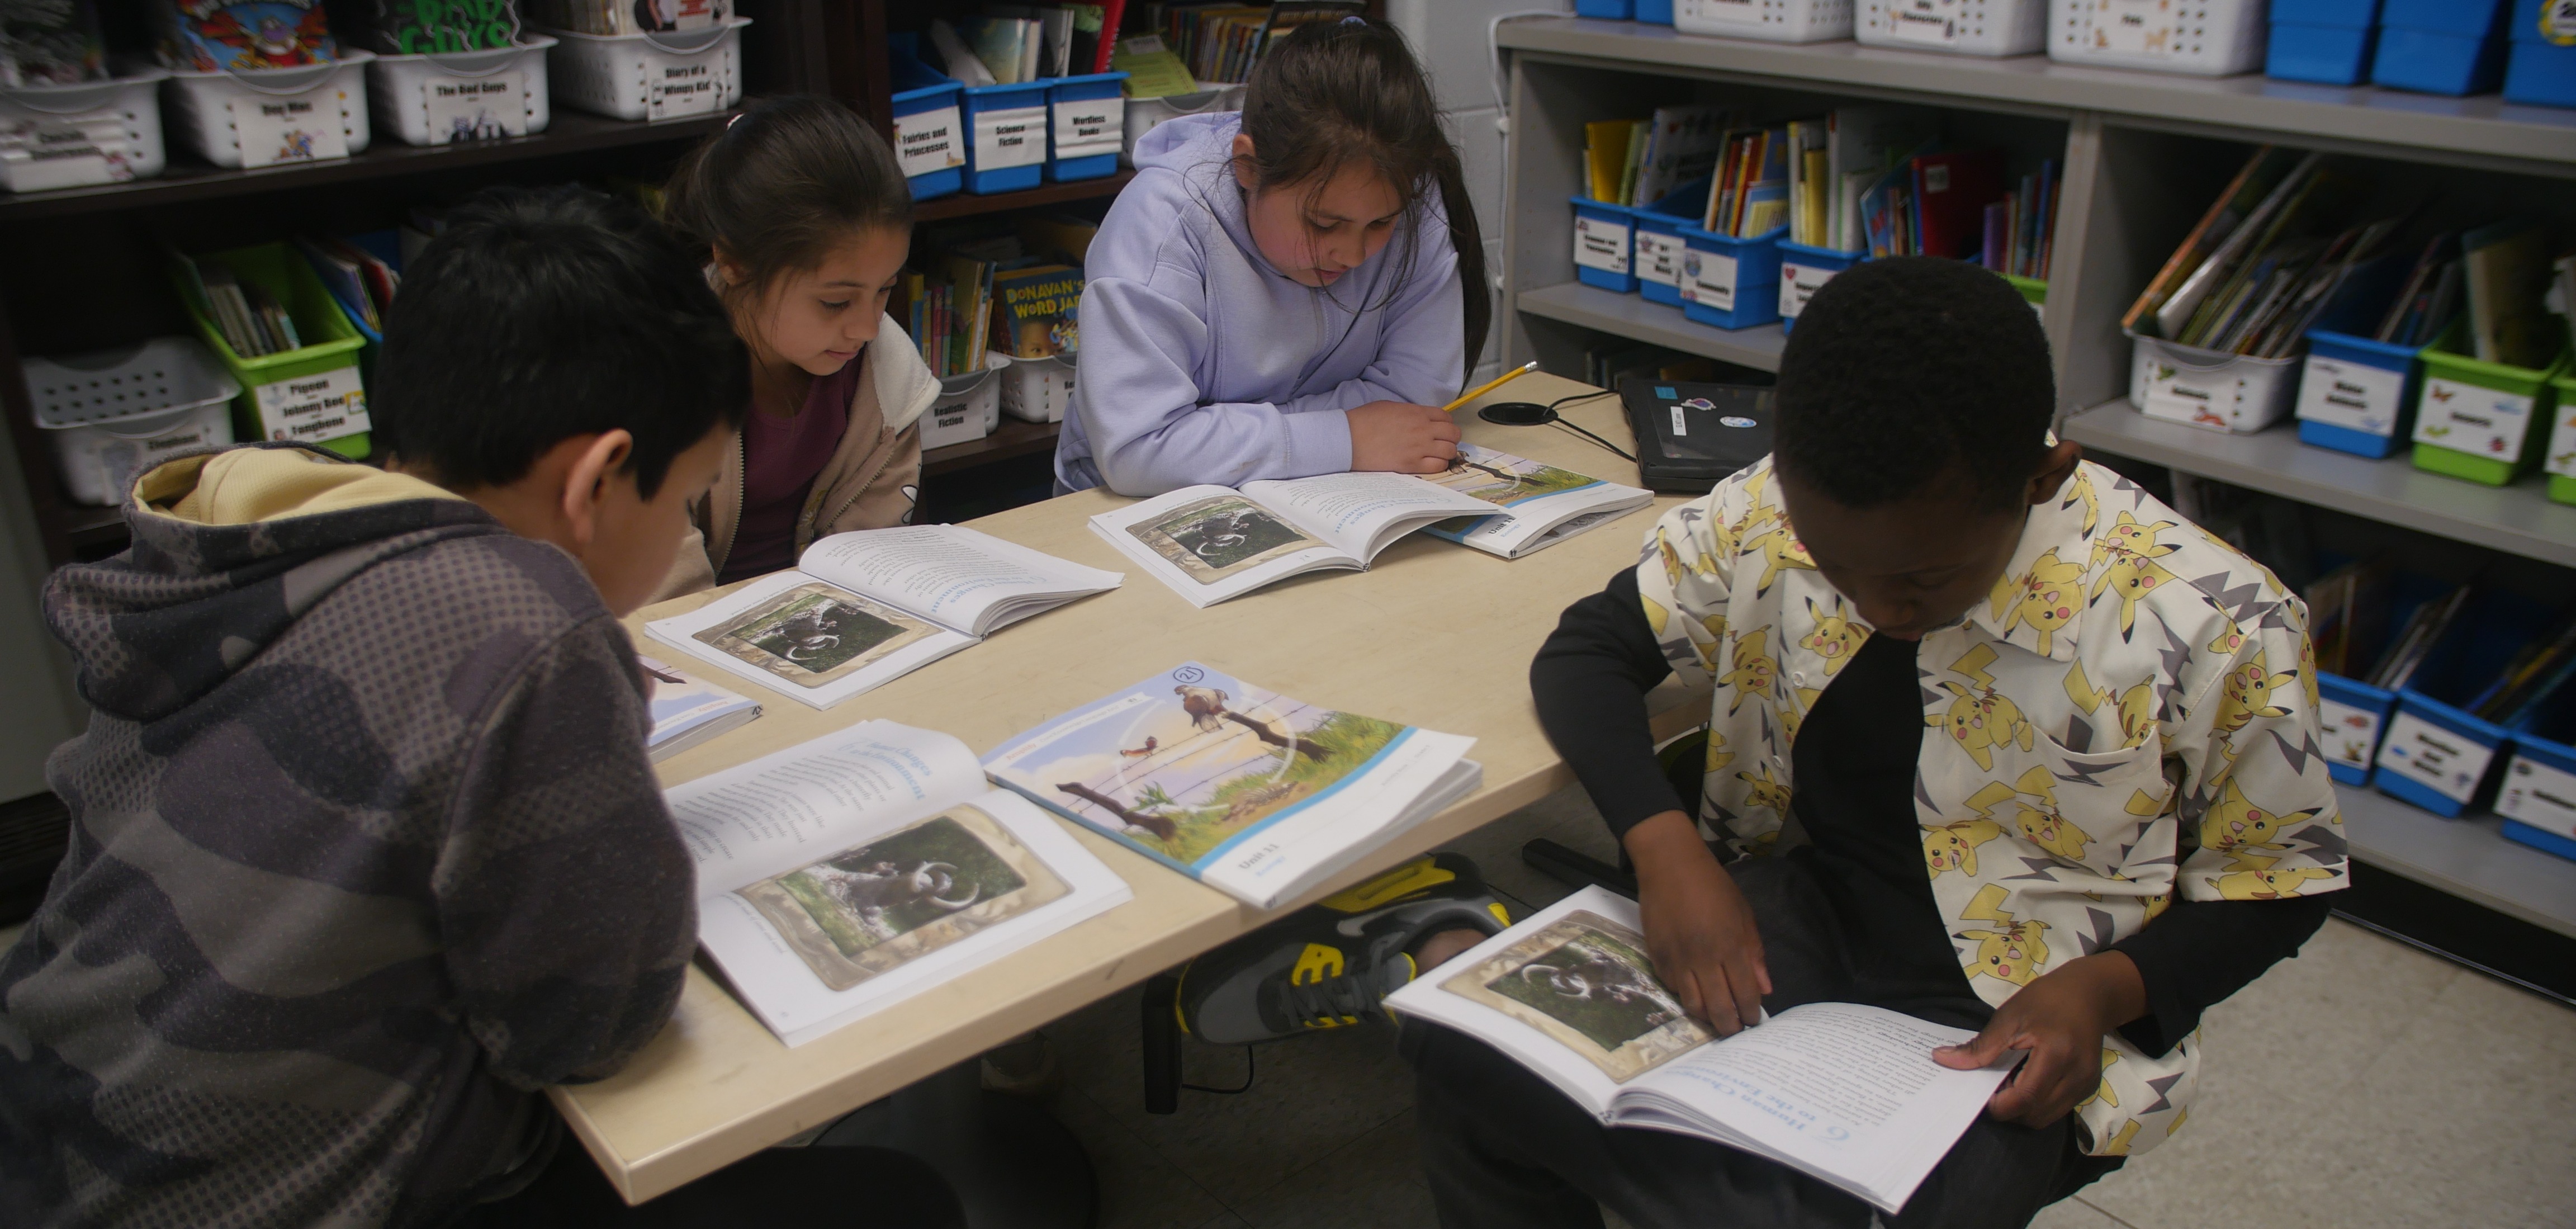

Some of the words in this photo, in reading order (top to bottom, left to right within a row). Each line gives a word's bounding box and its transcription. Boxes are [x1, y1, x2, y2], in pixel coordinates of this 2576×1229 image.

[666, 68, 688, 79] Diary
[691, 65, 699, 75] of
[701, 66, 707, 74] a
[436, 86, 457, 97] The
[458, 84, 479, 94] Bad
[481, 82, 506, 94] Guys
[664, 84, 693, 95] Wimpy
[695, 80, 711, 91] Kid
[1072, 114, 1106, 126] Wordless
[903, 131, 932, 144] Fairies
[932, 127, 948, 139] and
[996, 124, 1026, 135] Science
[1078, 127, 1100, 137] Books
[998, 136, 1024, 146] Fiction
[904, 140, 949, 158] Princesses
[1006, 280, 1085, 304] DONAVAN'S
[1013, 301, 1057, 319] WORD
[289, 380, 330, 395] Pigeon
[283, 400, 322, 418] Johnny
[324, 396, 346, 409] Boo
[934, 402, 968, 417] Realistic
[291, 416, 346, 436] Fangbone
[938, 415, 965, 429] Fiction
[1335, 500, 1395, 533] Environment
[1350, 504, 1393, 524] Changes
[1488, 522, 1507, 535] Unit
[1506, 517, 1517, 526] 11
[931, 579, 992, 613] Environment
[950, 583, 994, 603] Changes
[1179, 669, 1197, 680] 21
[698, 701, 729, 713] Amplify
[1006, 742, 1037, 761] Amplify
[896, 748, 931, 776] Changes
[874, 753, 924, 799] Environment
[877, 775, 894, 790] animal
[852, 781, 872, 800] butterfly
[864, 780, 880, 794] plants
[834, 794, 847, 806] other
[851, 797, 863, 811] same
[774, 823, 787, 836] made
[778, 810, 789, 820] They
[788, 820, 806, 843] hunted
[815, 816, 825, 828] like
[748, 830, 759, 841] only
[761, 826, 773, 838] their
[719, 844, 733, 859] create
[1238, 852, 1266, 869] Unit
[1263, 843, 1280, 853] 11
[1921, 1032, 1944, 1041] things
[1767, 1095, 1793, 1110] the
[1742, 1095, 1805, 1130] Human
[1798, 1110, 1816, 1121] to
[1826, 1127, 1850, 1141] 6
